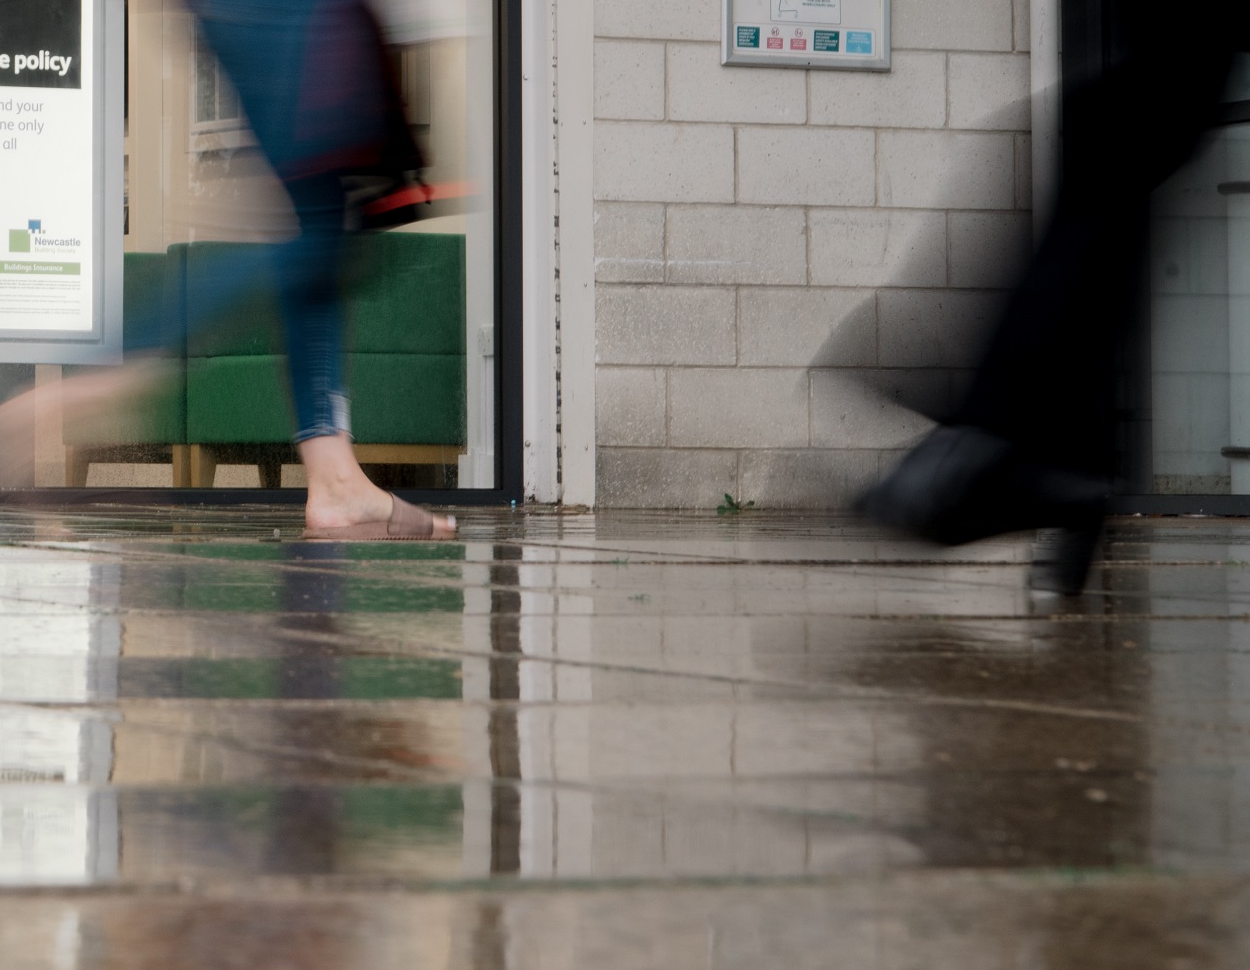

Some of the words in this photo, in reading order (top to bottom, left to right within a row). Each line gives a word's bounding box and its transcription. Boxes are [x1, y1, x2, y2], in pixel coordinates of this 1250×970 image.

[14, 50, 73, 77] policy
[16, 101, 44, 115] your
[18, 119, 45, 134] only
[2, 137, 17, 150] all
[34, 237, 81, 247] Newcastle
[4, 263, 32, 273] Buildings
[33, 264, 63, 273] Insurance
